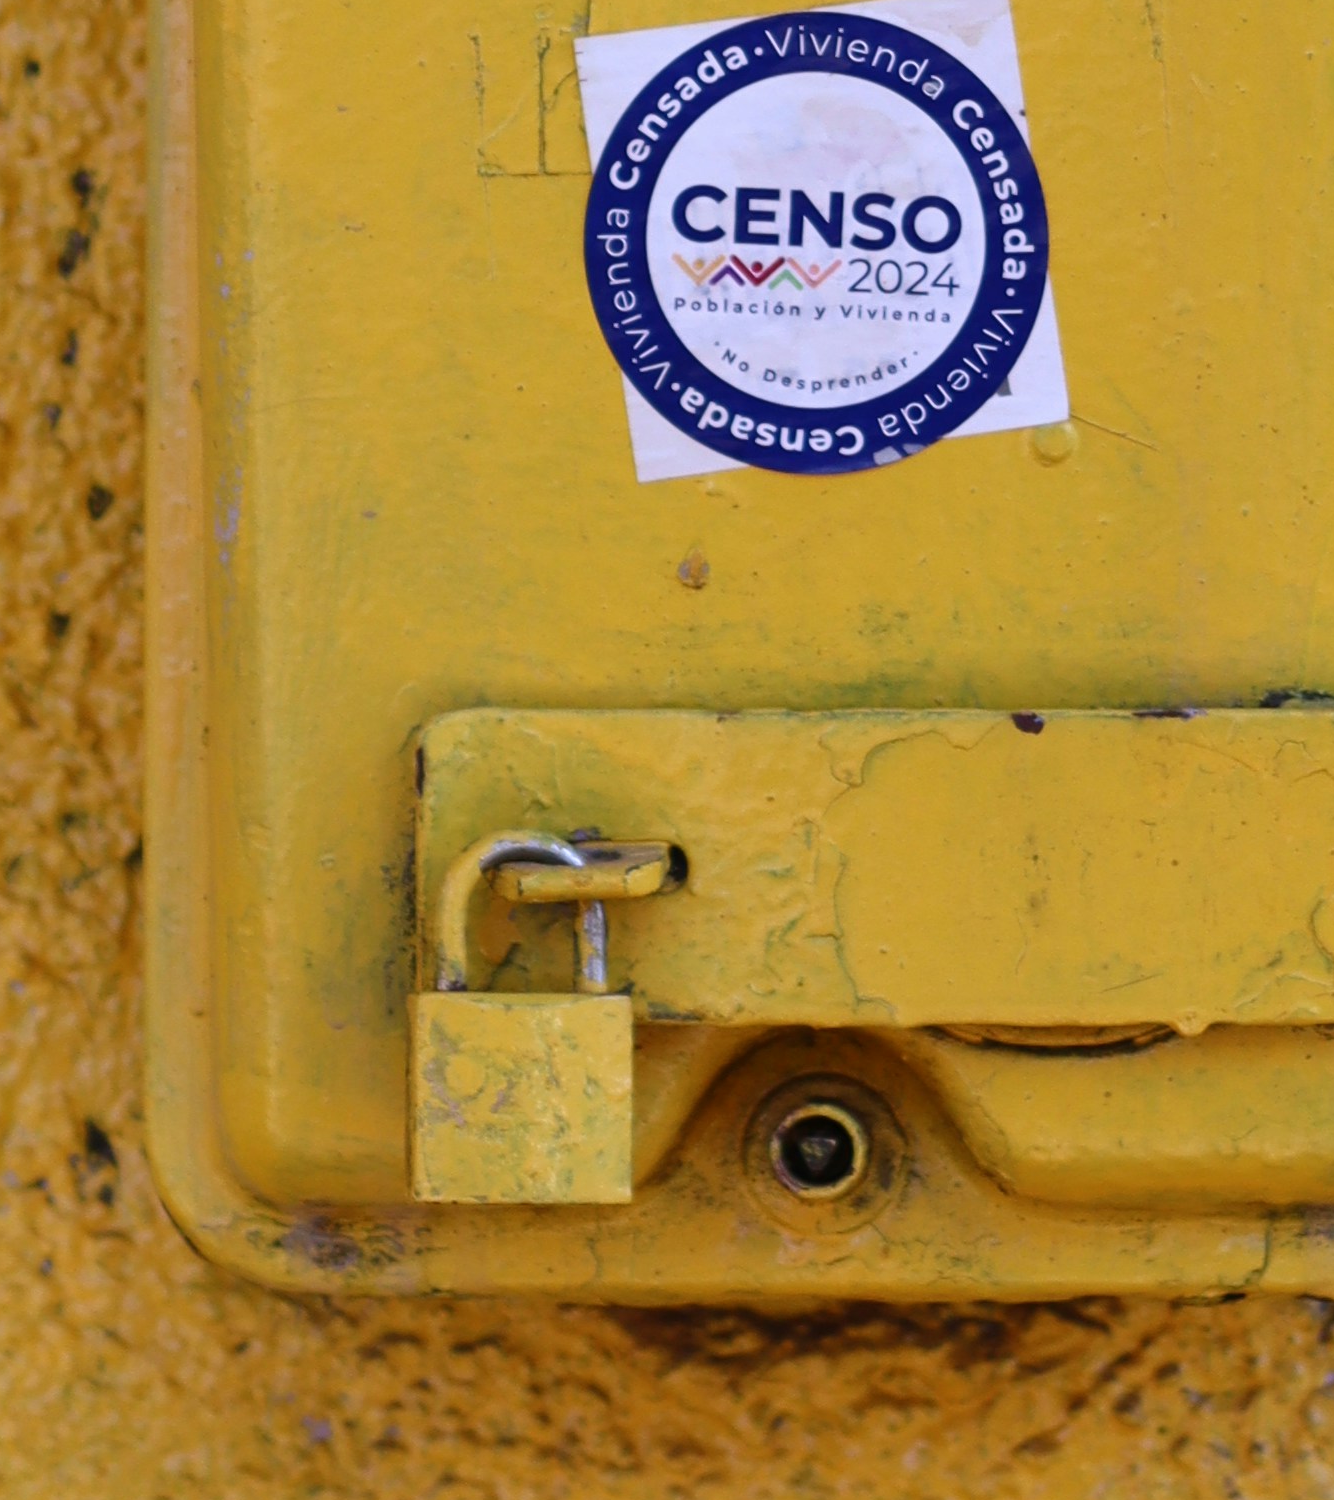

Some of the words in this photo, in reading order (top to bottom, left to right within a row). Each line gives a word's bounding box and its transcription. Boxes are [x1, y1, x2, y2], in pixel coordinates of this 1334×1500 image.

[608, 42, 749, 192] Censada
[765, 24, 947, 101] Vivienda
[950, 98, 1035, 288] Censada
[670, 183, 963, 254] CENSO
[596, 205, 672, 392] Vivienda
[674, 296, 801, 318] Población
[814, 306, 826, 320] y
[841, 305, 952, 324] Vivienda
[847, 257, 962, 299] 2024
[721, 348, 750, 373] No
[762, 355, 909, 394] Desprender
[876, 304, 1025, 438] Vivienda
[679, 384, 866, 458] Censada
